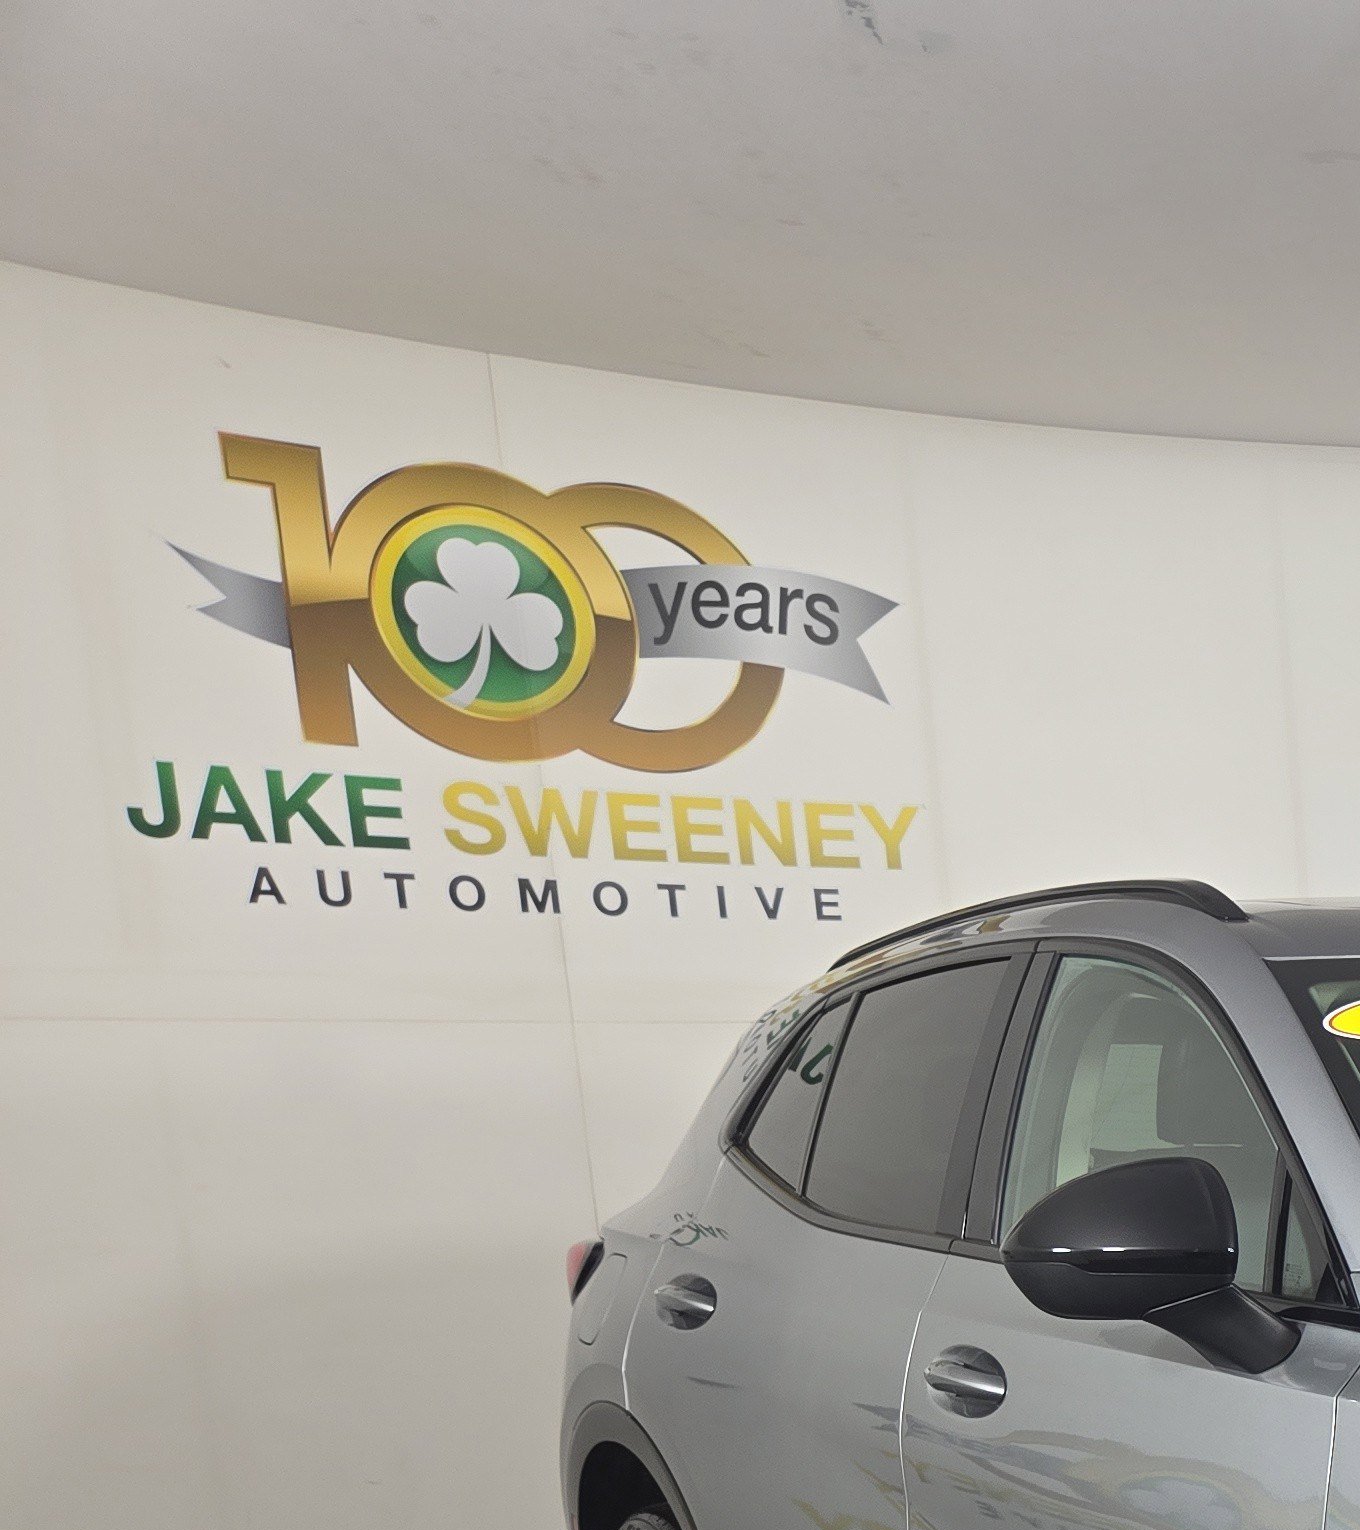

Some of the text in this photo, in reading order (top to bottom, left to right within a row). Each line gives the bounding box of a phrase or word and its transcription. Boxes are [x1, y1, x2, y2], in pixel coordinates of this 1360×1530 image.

[647, 579, 841, 646] years
[127, 760, 919, 870] JAKE SWEENEY
[249, 866, 843, 921] AUTOMOTIVE
